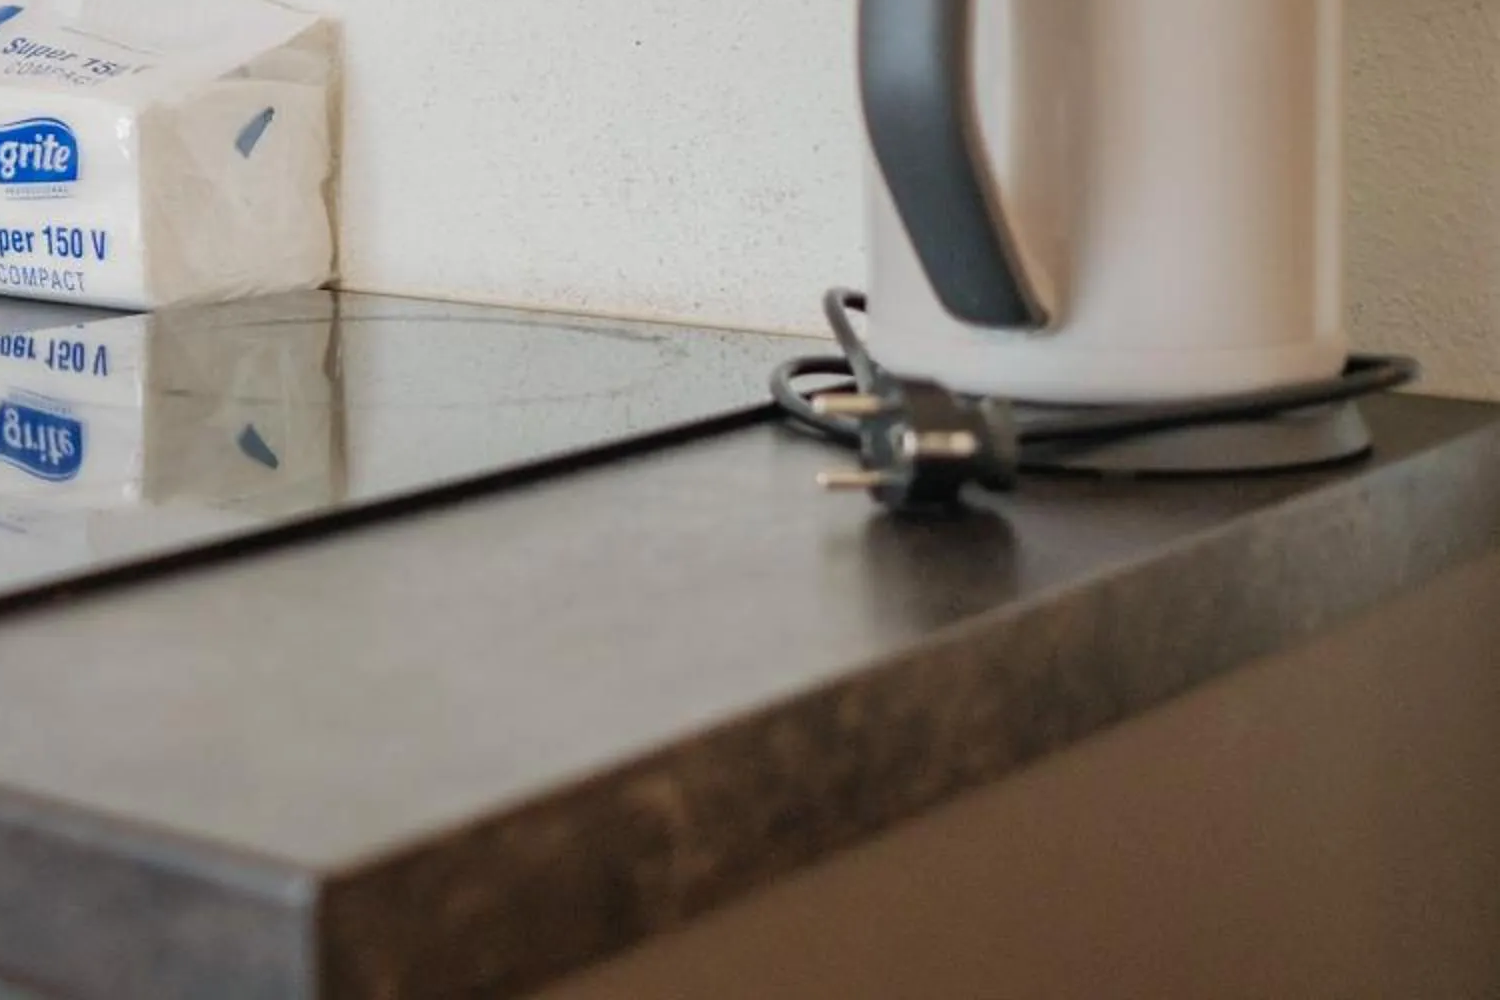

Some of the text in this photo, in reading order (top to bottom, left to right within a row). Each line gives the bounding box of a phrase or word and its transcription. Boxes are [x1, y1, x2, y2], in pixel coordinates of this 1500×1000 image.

[3, 37, 78, 61] Super
[42, 225, 83, 259] 150
[91, 229, 106, 261] V
